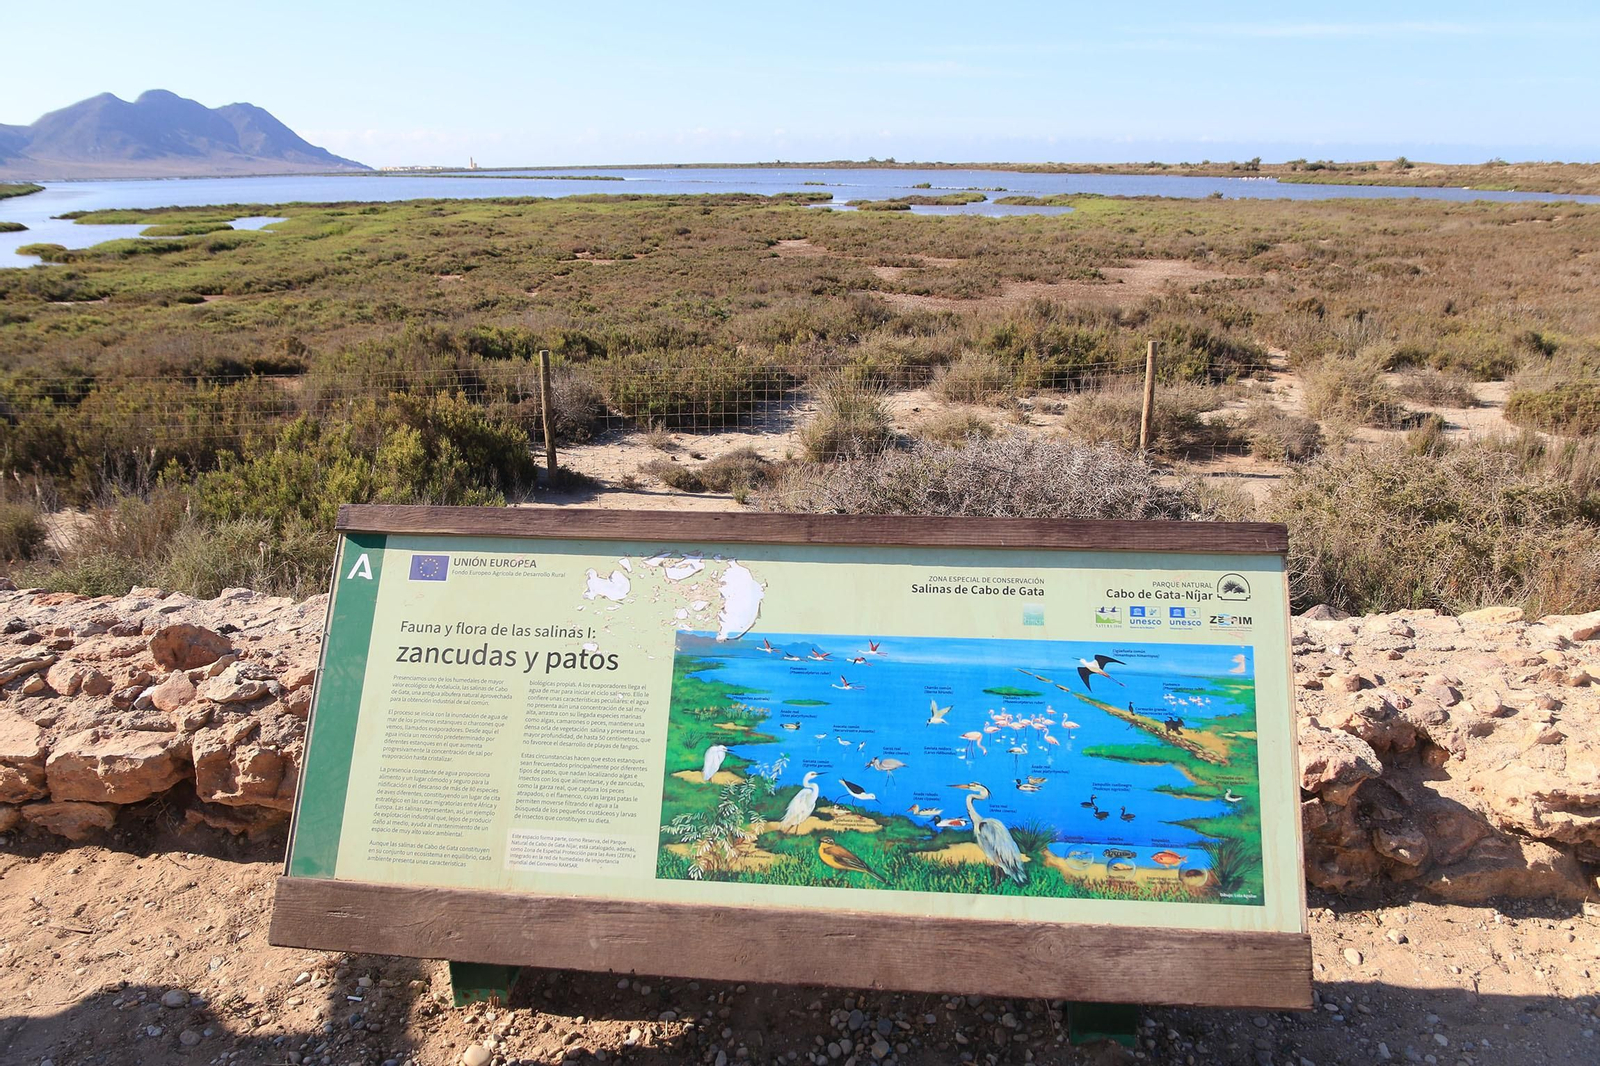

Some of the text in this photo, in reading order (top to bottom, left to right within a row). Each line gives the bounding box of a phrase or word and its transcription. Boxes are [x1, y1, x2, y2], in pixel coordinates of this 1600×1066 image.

[454, 556, 537, 568] UNIÓN EUROPEA
[912, 584, 1045, 596] Salinas de Cabo de Gata
[1106, 589, 1213, 602] Cabo de Gata-Níjar
[400, 621, 441, 633] Fauna
[444, 624, 452, 636] y
[456, 622, 487, 635] flora
[491, 624, 507, 636] de
[512, 624, 530, 636] las
[534, 625, 583, 638] salinas
[396, 643, 619, 674] zancudas y patos
